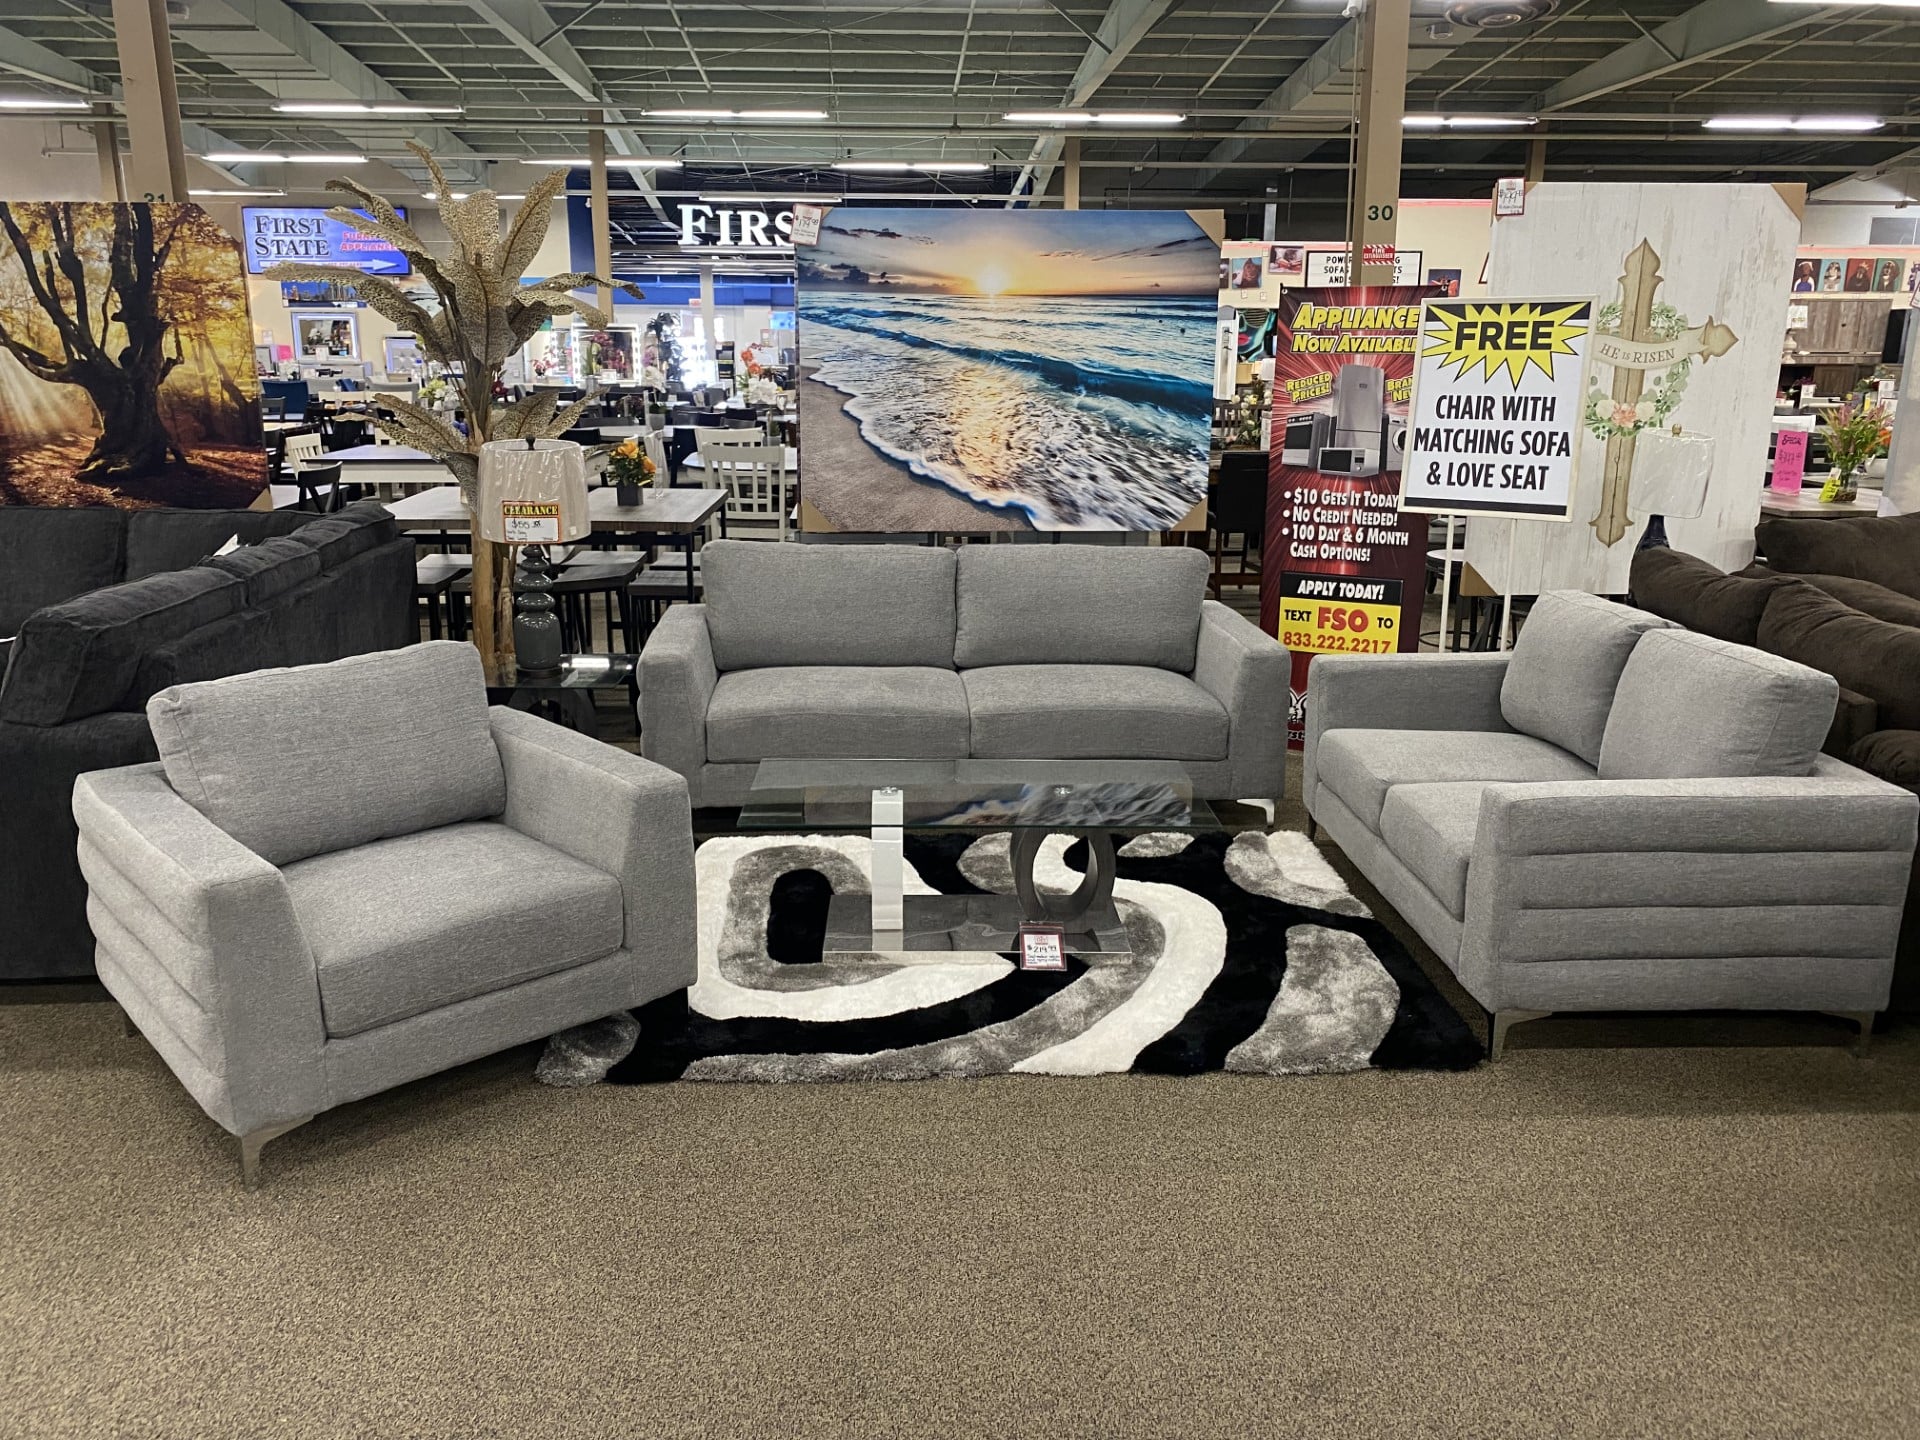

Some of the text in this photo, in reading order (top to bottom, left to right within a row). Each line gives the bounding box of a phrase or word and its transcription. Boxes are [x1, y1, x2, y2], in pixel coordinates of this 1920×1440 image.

[1367, 205, 1394, 221] 30
[255, 215, 325, 235] FIRST
[677, 204, 794, 247] FIRS
[255, 237, 329, 257] STATE
[341, 242, 398, 251] APPLIANCE
[1329, 276, 1344, 284] AND
[1291, 303, 1420, 329] APPLIANCE
[1292, 333, 1335, 352] NOW
[1455, 320, 1554, 350] FREE
[1599, 343, 1676, 363] HE IS RISEN
[1286, 373, 1332, 391] REDUCED
[1292, 384, 1331, 402] PRICES!
[1436, 395, 1556, 422] CHAIR WITH
[1413, 427, 1571, 457] MATCHING SOFA
[1426, 461, 1549, 490] & LOVE SEAT
[1294, 486, 1318, 505] $10
[1321, 489, 1347, 506] GETS
[504, 505, 558, 515] CLEARANCE
[1292, 506, 1398, 527] NO CREDIT NEEDED!
[1292, 524, 1409, 546] 100 DAY & 6 MONTH
[1290, 541, 1371, 562] CASH OPTIONS!
[1297, 580, 1385, 600] APPLY TODAY!
[1284, 606, 1393, 632] TEXT FSO TO
[1283, 631, 1391, 653] 833.222.2217
